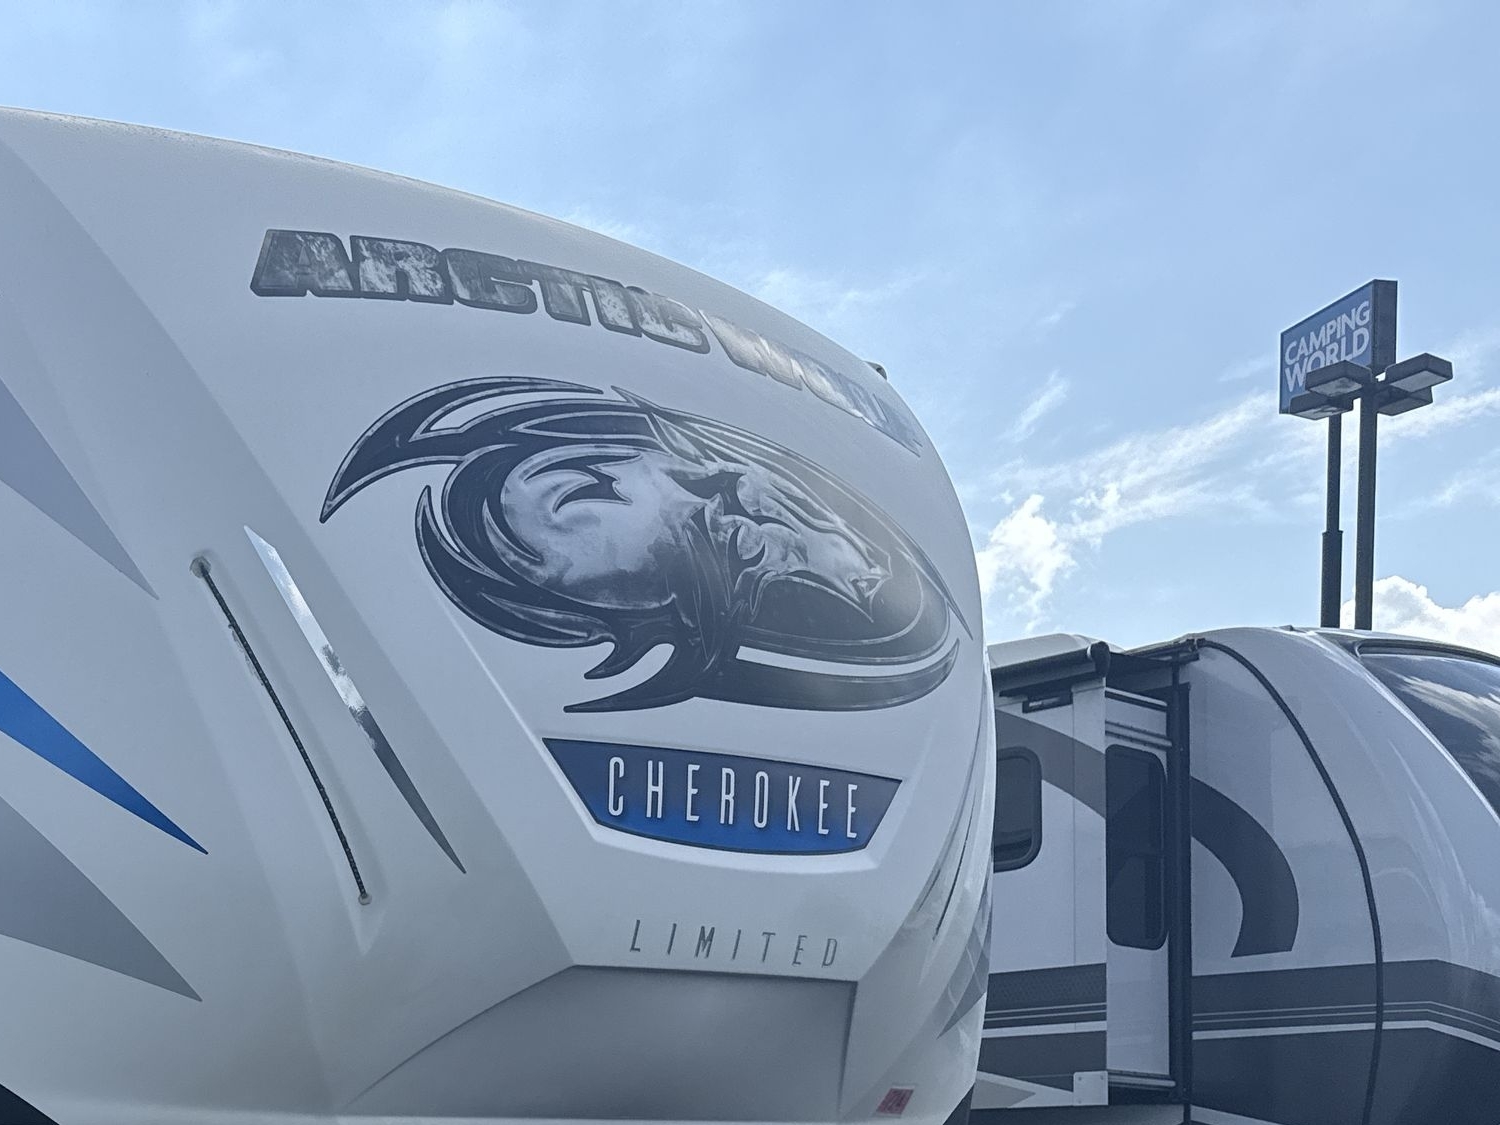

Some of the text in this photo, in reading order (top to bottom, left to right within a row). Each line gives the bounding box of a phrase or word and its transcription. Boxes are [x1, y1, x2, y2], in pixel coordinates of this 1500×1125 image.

[249, 228, 712, 355] ARCTIC
[1285, 301, 1370, 365] CAMPING
[1285, 327, 1370, 392] WORLD
[607, 755, 860, 840] CHEROKEE
[629, 918, 839, 969] LIMITED
